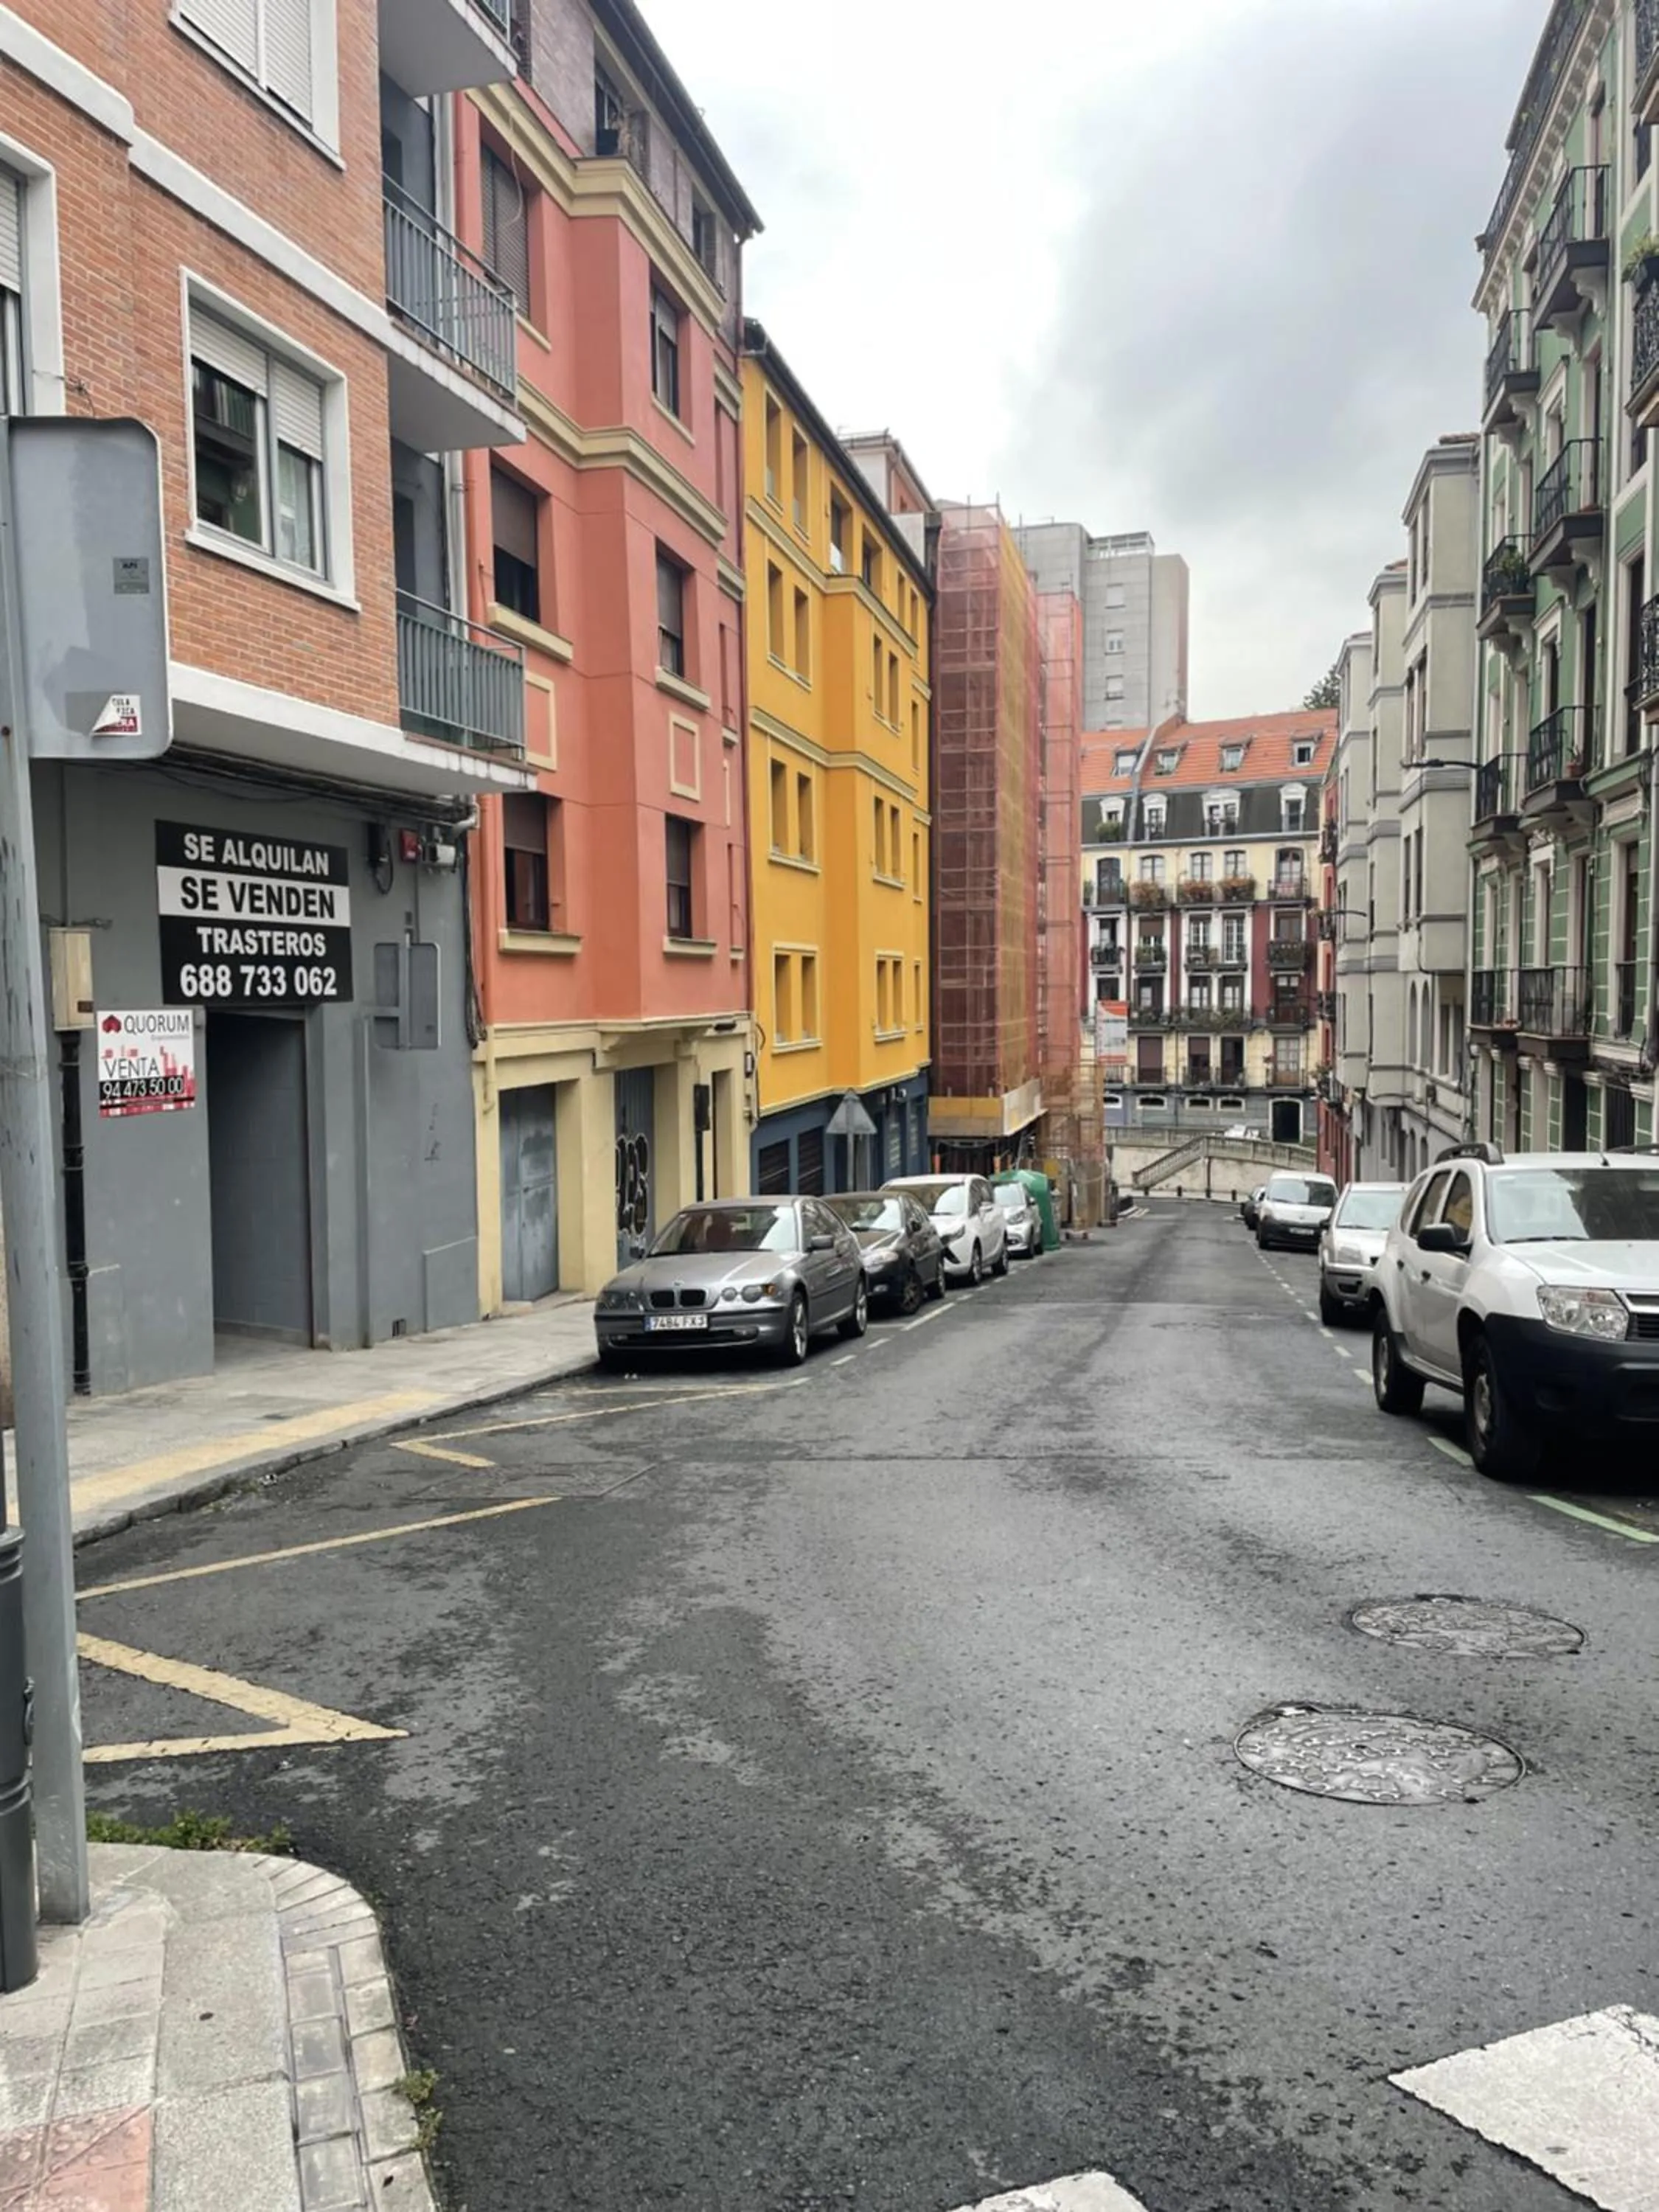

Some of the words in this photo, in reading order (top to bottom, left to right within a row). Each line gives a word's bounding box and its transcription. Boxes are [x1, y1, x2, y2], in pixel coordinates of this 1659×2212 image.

[184, 832, 215, 862] SE
[222, 838, 330, 876] ALQUILAN
[181, 876, 219, 911] SE
[227, 880, 335, 919] VENDEN
[196, 926, 327, 957] TRASTEROS
[180, 963, 233, 997] 688
[240, 964, 287, 996] 733
[294, 965, 338, 996] 062
[123, 1014, 189, 1035] QUORUM
[103, 1057, 160, 1079] VENTA
[102, 1082, 121, 1099] 94
[123, 1080, 146, 1097] 473
[149, 1079, 165, 1096] 50
[167, 1077, 183, 1093] 00
